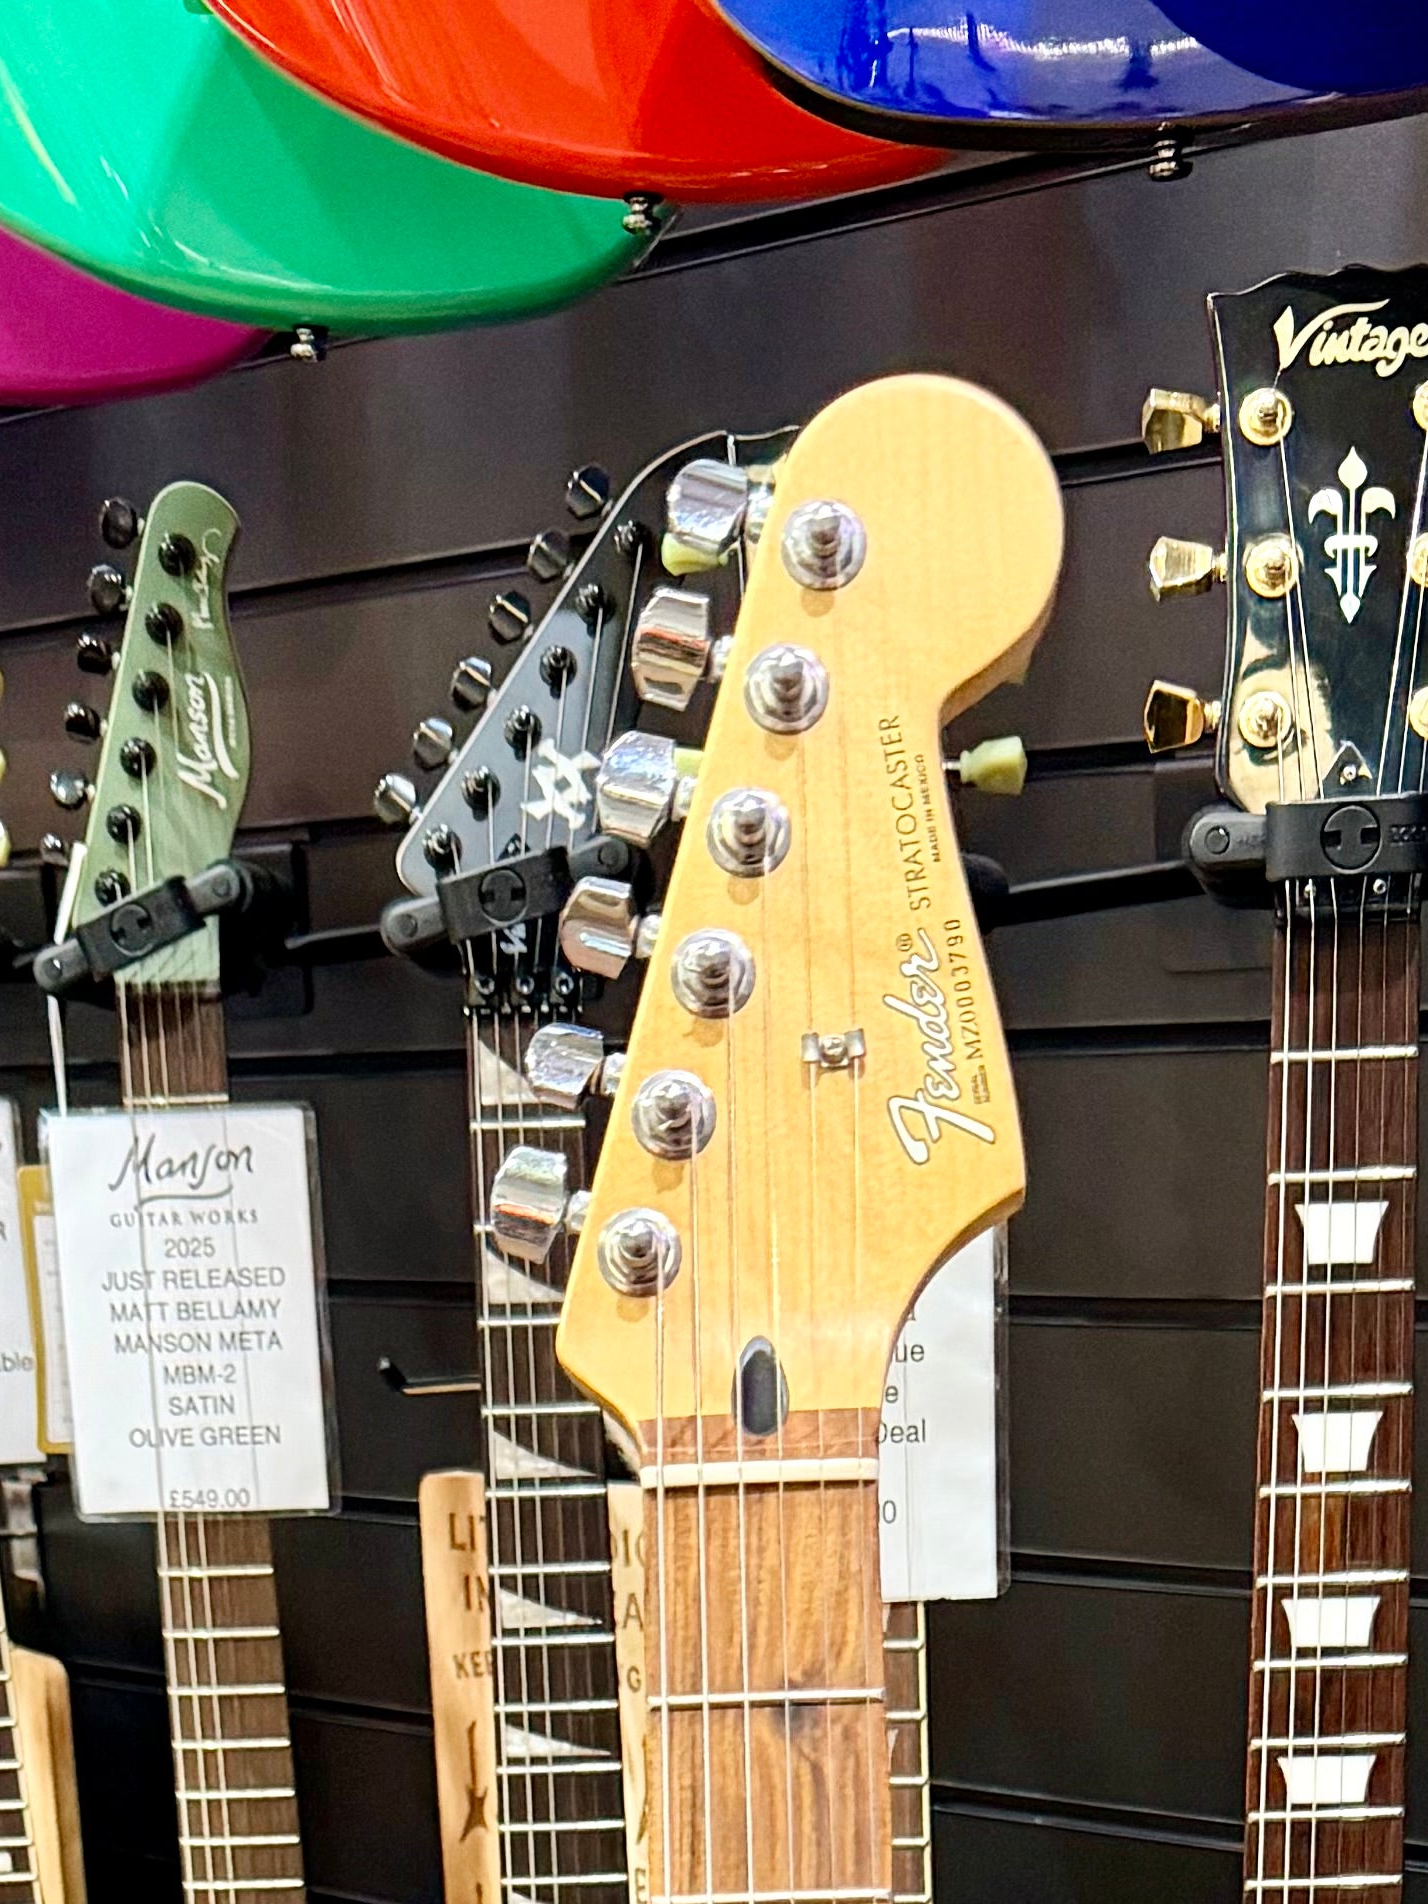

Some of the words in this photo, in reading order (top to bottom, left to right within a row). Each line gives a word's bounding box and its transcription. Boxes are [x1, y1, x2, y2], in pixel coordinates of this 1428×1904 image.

[176, 671, 227, 809] Manson
[914, 754, 934, 802] MEXICO
[878, 714, 932, 913] STRATOCASTER
[924, 803, 937, 821] IN
[927, 823, 942, 863] MADE
[943, 919, 982, 1061] MZ0003790
[882, 926, 996, 1166] Fender
[109, 1134, 254, 1203] Manson
[110, 1210, 183, 1228] GUITAR
[188, 1208, 259, 1226] WORKS
[164, 1238, 216, 1259] 2025
[102, 1269, 154, 1291] JUST
[162, 1267, 286, 1290] RELEASED
[110, 1302, 170, 1323] MATT
[176, 1299, 281, 1321] BELLAMY
[114, 1333, 212, 1354] MANSON
[218, 1331, 283, 1352] META
[163, 1365, 237, 1384] MBM-2
[168, 1395, 235, 1416] SATIN
[128, 1427, 194, 1448] OLIVE
[200, 1426, 282, 1446] GREEN
[170, 1489, 251, 1509] £549.00
